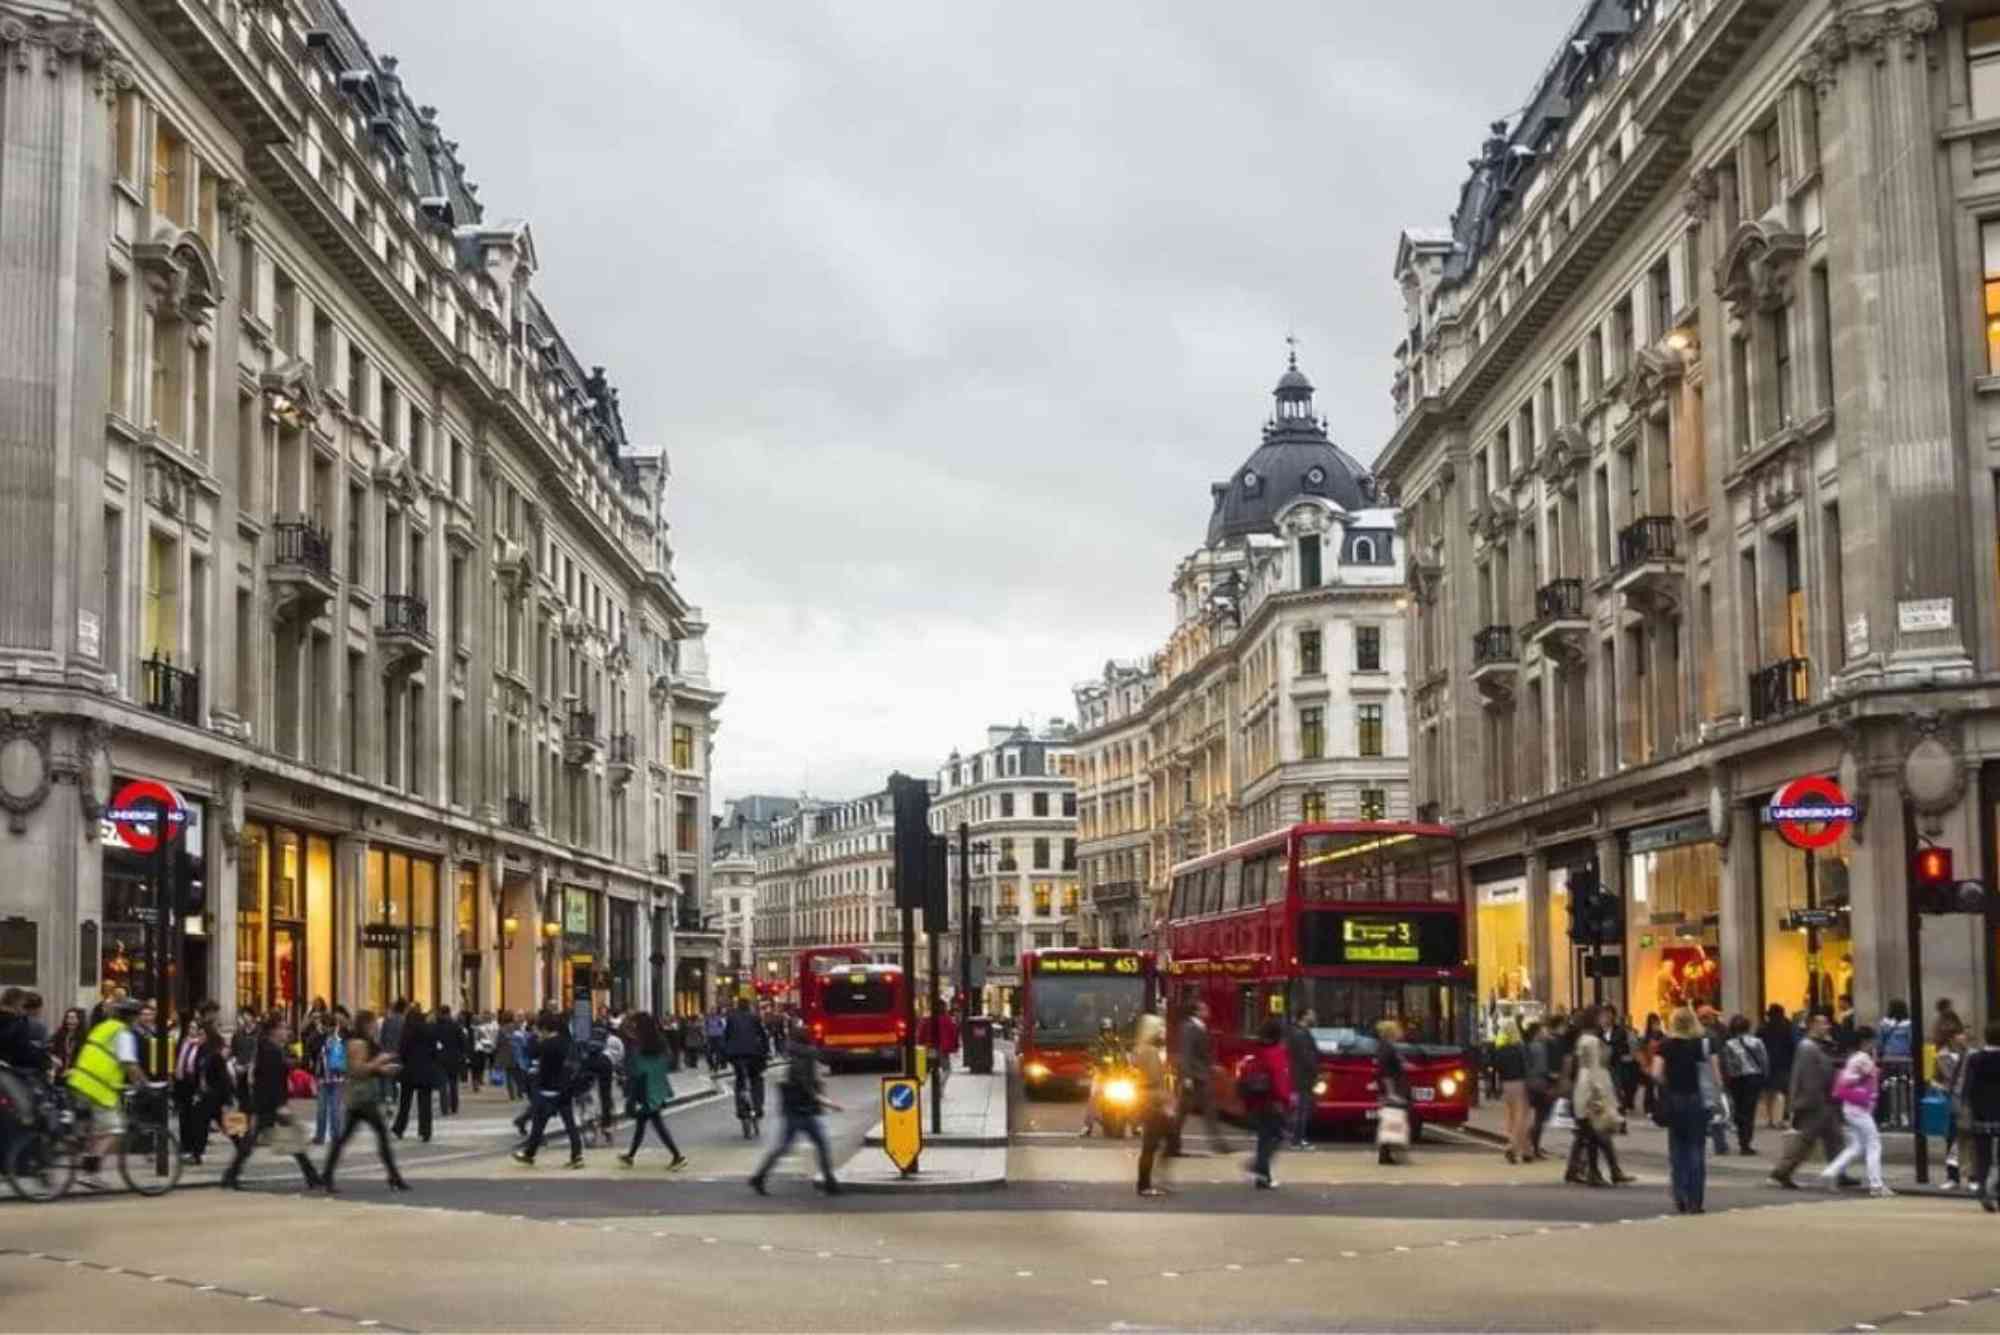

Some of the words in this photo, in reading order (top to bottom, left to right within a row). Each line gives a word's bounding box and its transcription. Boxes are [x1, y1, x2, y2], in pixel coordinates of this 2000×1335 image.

[108, 811, 184, 821] UNDERGRND
[1774, 807, 1853, 818] UNDERGROUND
[1115, 958, 1137, 973] 453
